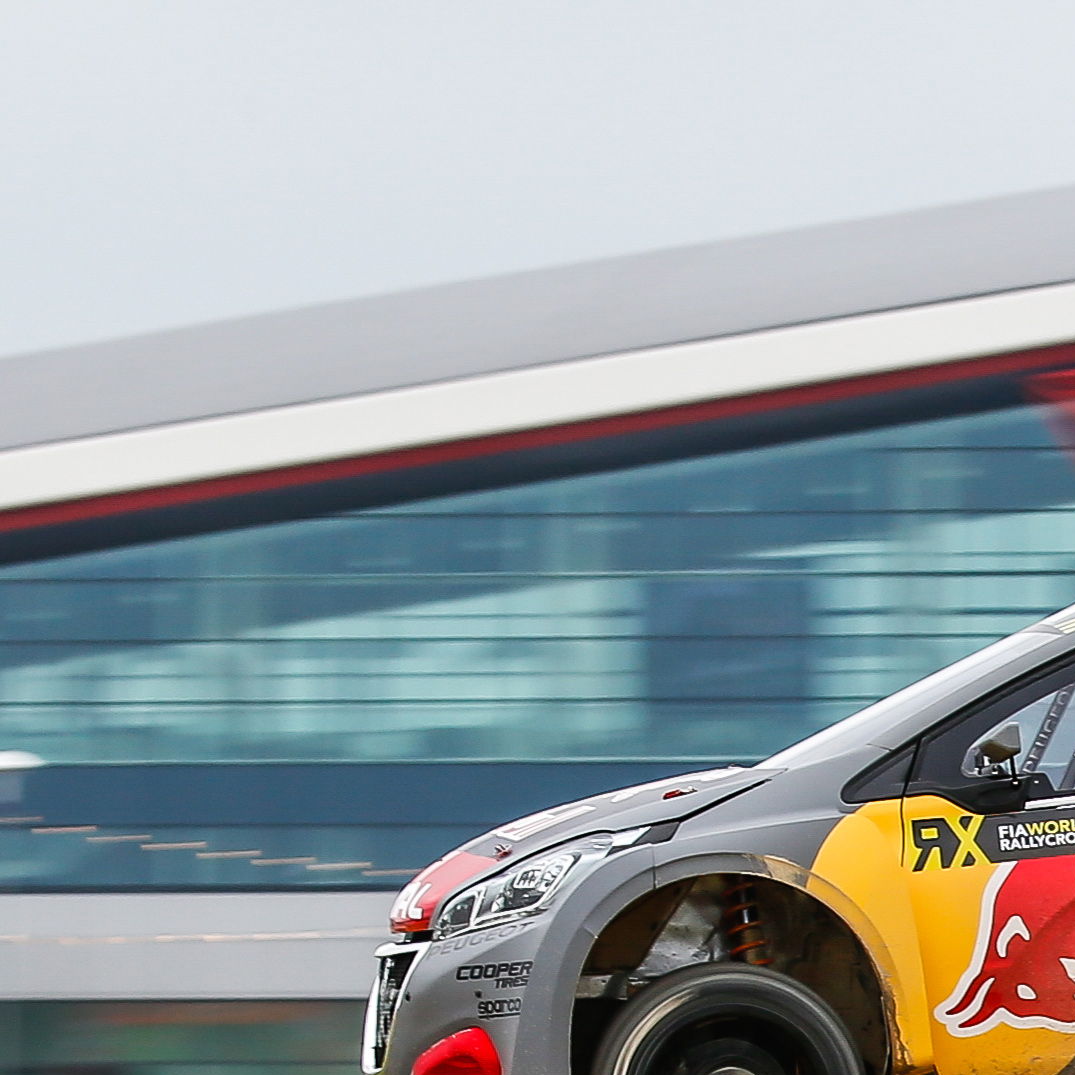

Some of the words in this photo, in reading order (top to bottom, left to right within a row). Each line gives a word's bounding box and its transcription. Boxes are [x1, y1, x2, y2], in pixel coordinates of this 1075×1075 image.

[427, 921, 536, 960] PEUGEOT
[456, 961, 534, 981] COOPER
[494, 976, 530, 989] TIRES
[478, 998, 522, 1019] sparco
